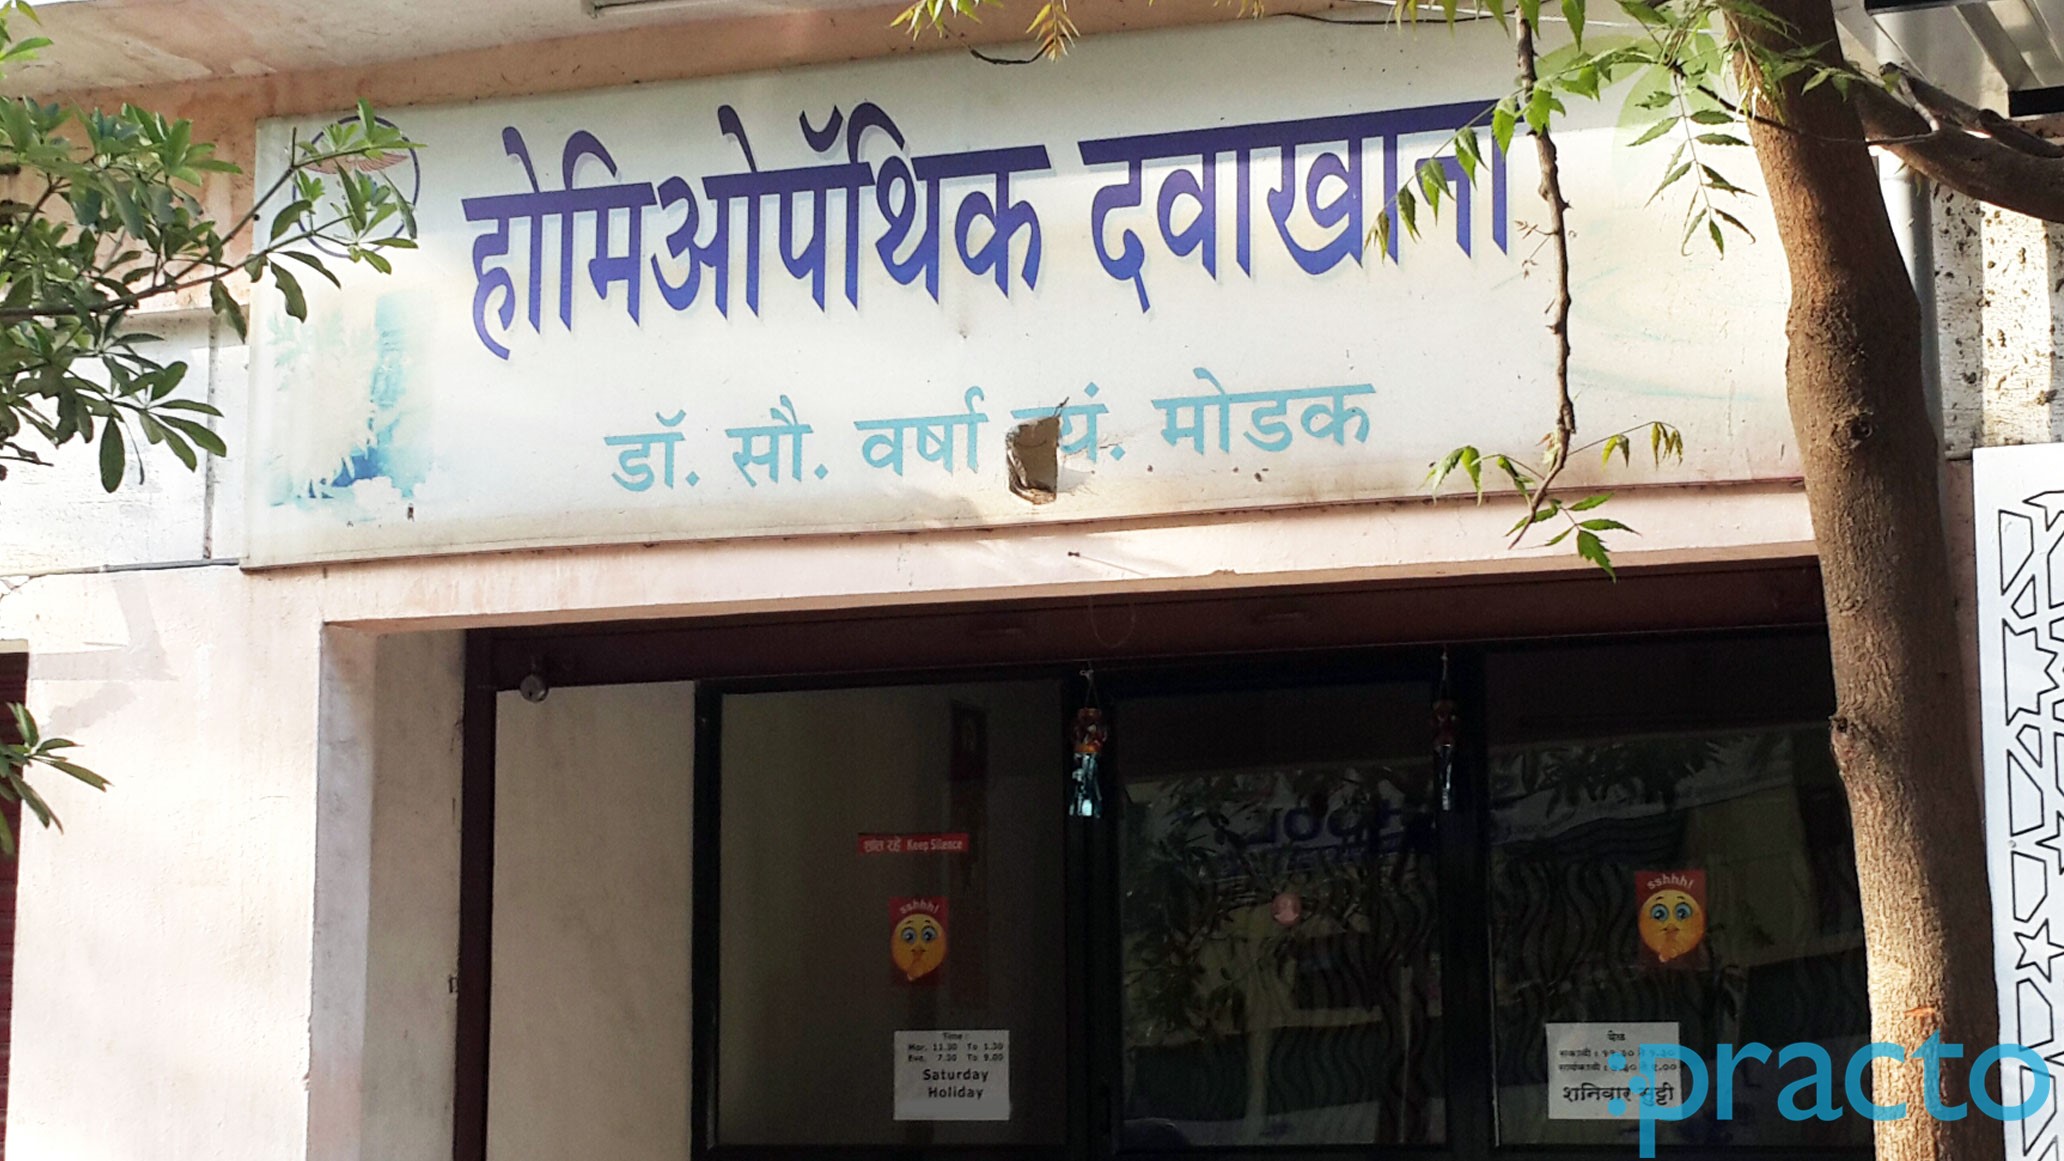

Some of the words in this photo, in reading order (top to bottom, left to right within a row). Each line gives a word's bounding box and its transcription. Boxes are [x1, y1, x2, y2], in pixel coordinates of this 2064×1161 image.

[462, 101, 1052, 360] होमिओपॅथिक
[1077, 99, 1525, 313] दवाखाना
[605, 410, 700, 492] डॉ.
[725, 394, 828, 488] सौ.
[855, 386, 988, 475] वर्षा
[1152, 367, 1375, 456] मोडक
[907, 839, 929, 852] Keep
[930, 838, 963, 850] Silence
[1647, 873, 1694, 890] sshhh!
[923, 1068, 989, 1082] Saturday
[928, 1086, 984, 1100] Holiday
[1563, 1082, 1632, 1103] शनिवार
